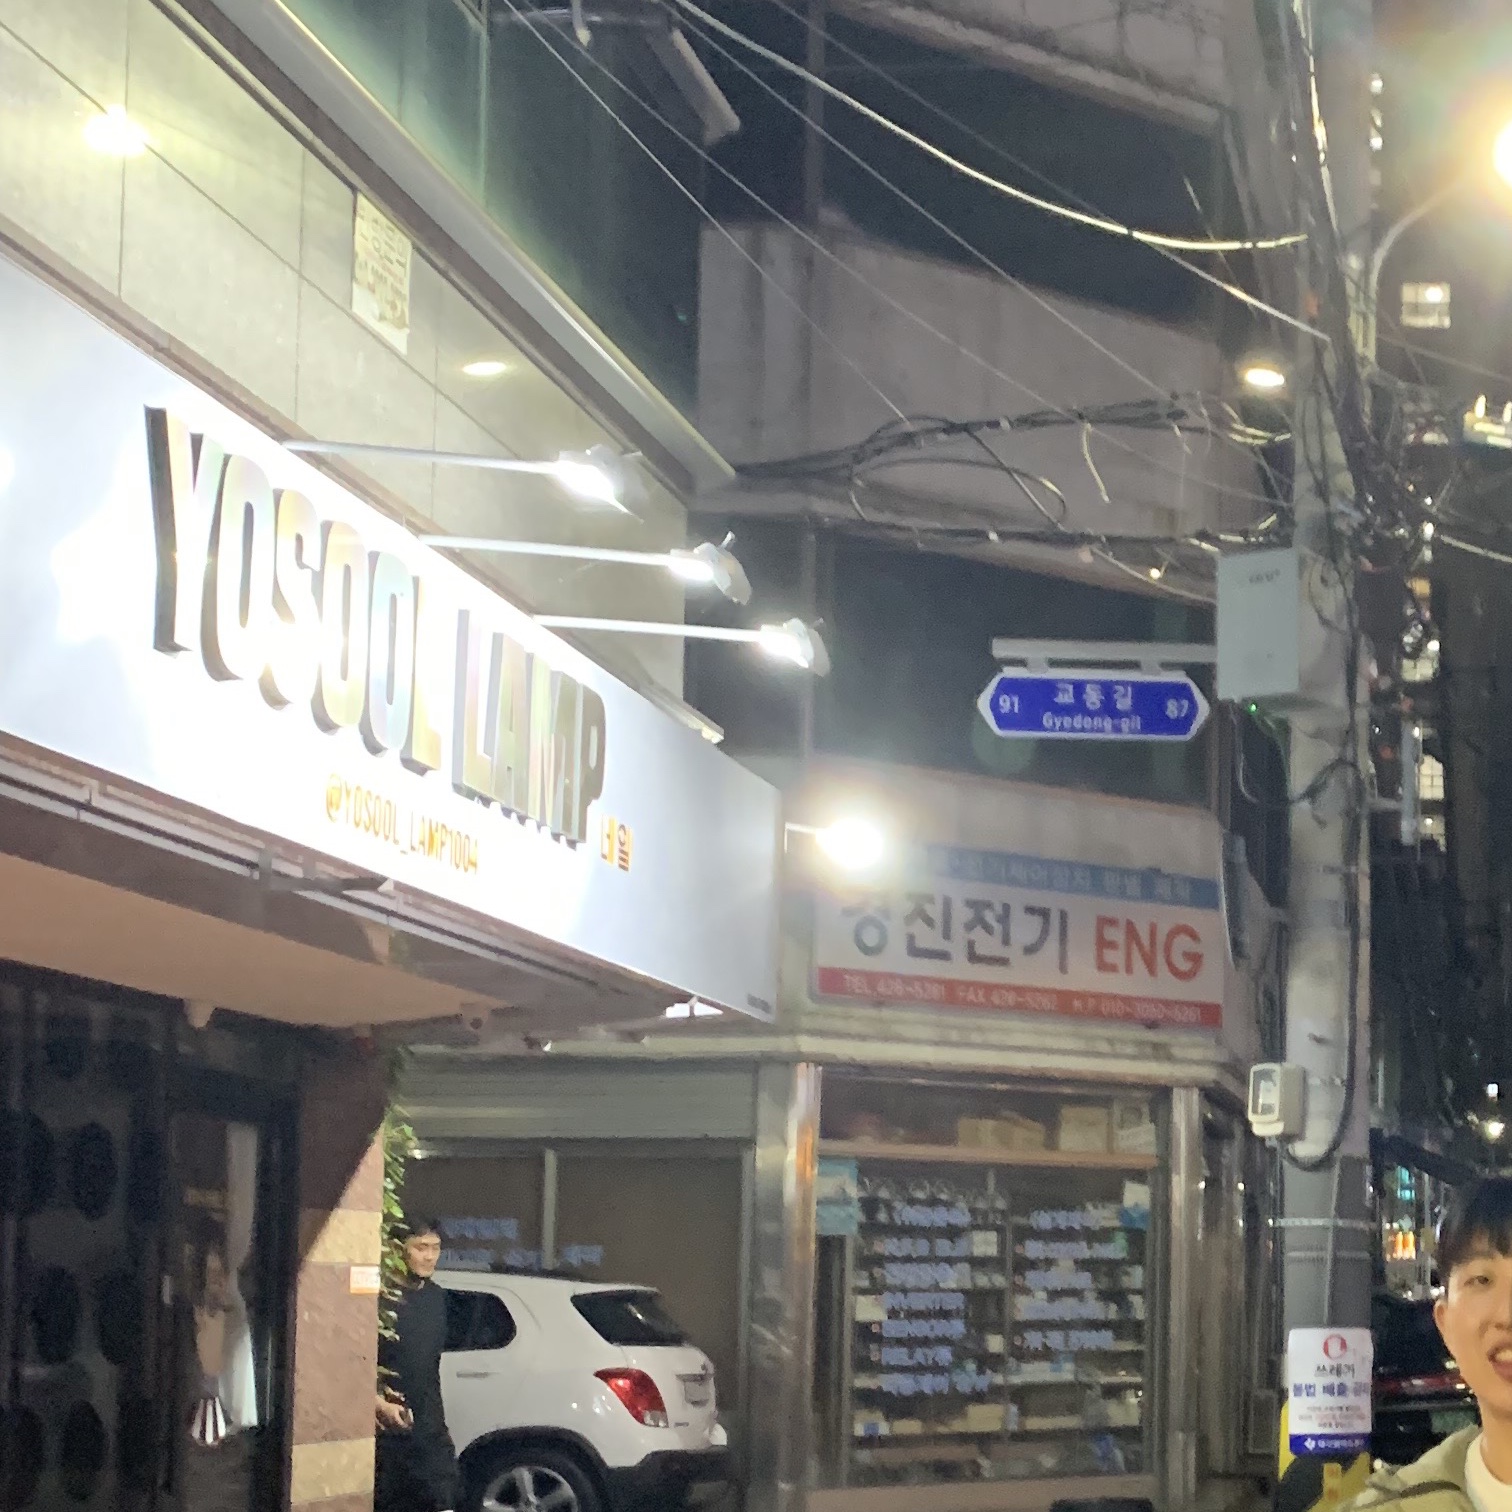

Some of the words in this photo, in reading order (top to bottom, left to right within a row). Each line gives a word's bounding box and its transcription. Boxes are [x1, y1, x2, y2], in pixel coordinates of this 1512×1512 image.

[144, 403, 442, 778] YOSOOL
[451, 608, 607, 851] LAMP
[998, 694, 1020, 714] 91
[1053, 682, 1134, 711] 교동길
[1164, 698, 1190, 720] 87
[1095, 914, 1204, 983] ENG
